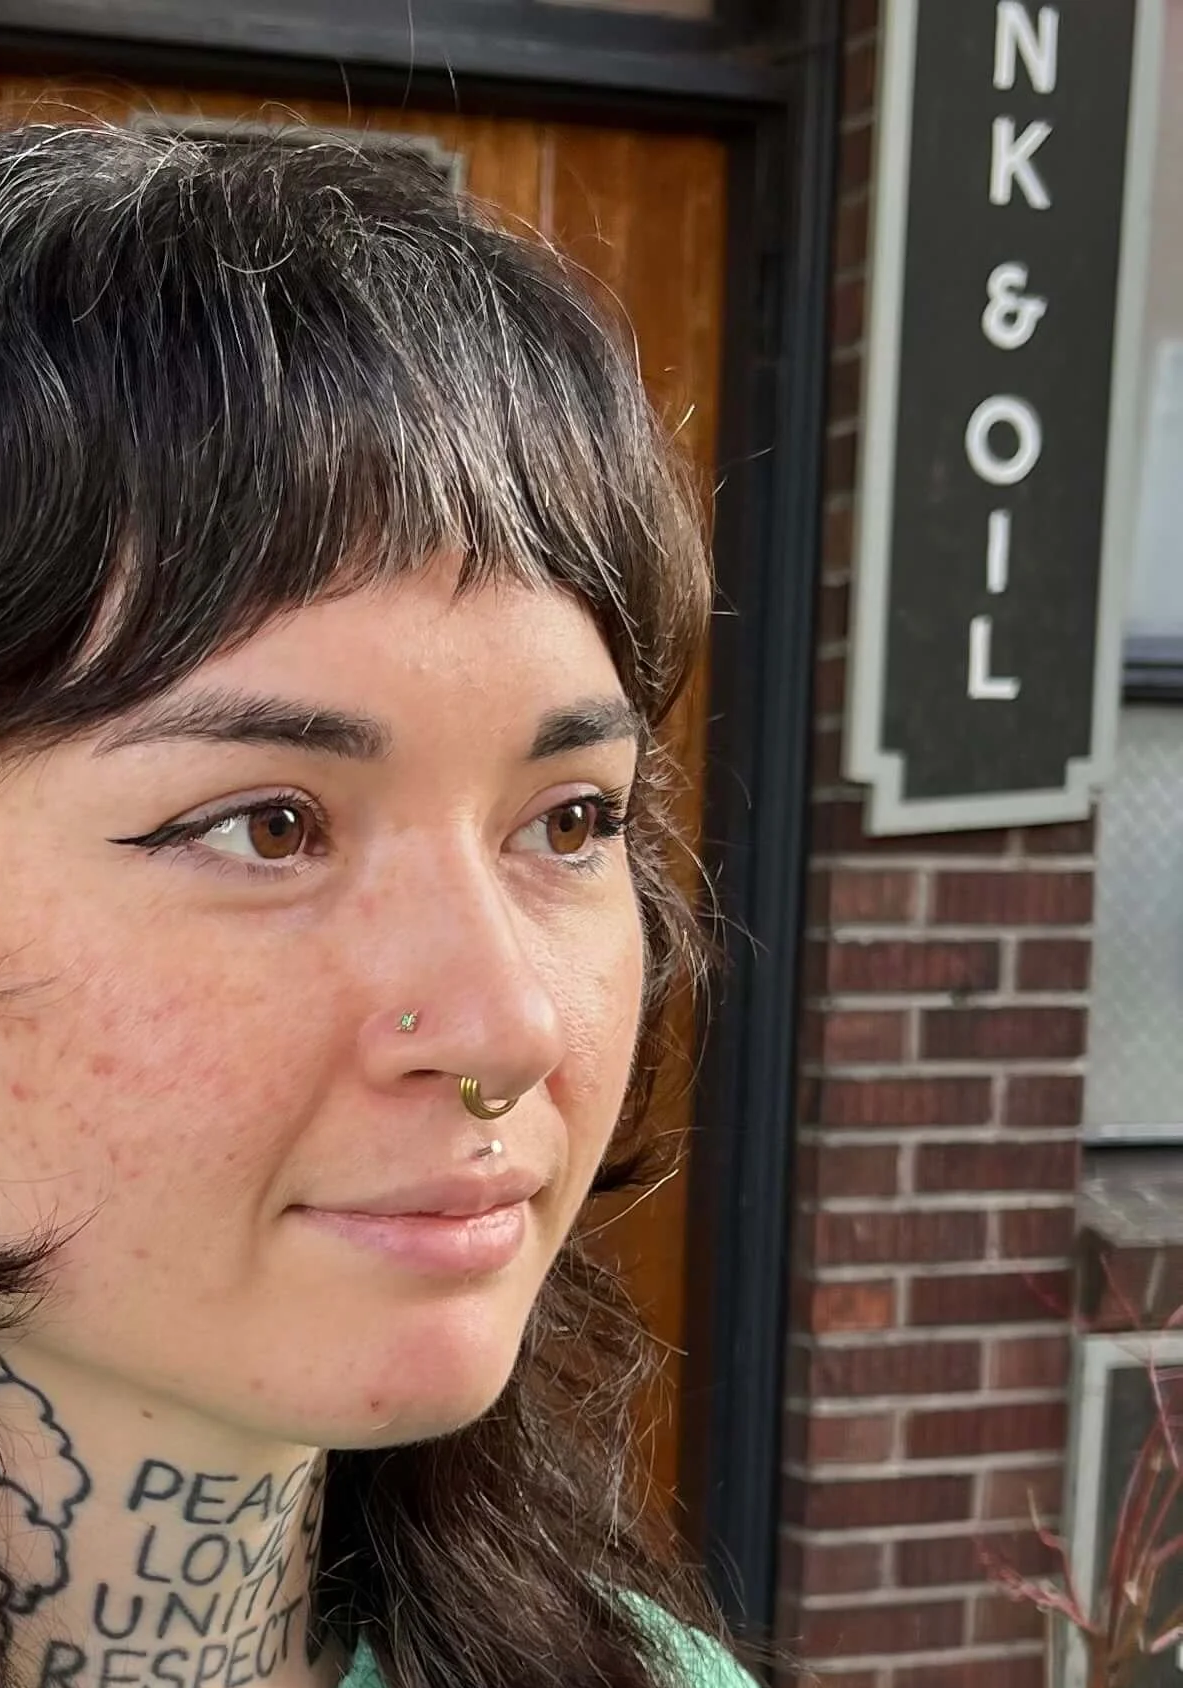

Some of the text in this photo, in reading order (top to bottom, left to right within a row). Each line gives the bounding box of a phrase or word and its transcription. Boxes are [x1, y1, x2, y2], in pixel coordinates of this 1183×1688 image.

[980, 261, 1048, 350] &
[965, 396, 1043, 700] OIL
[92, 1543, 296, 1640] UNITY
